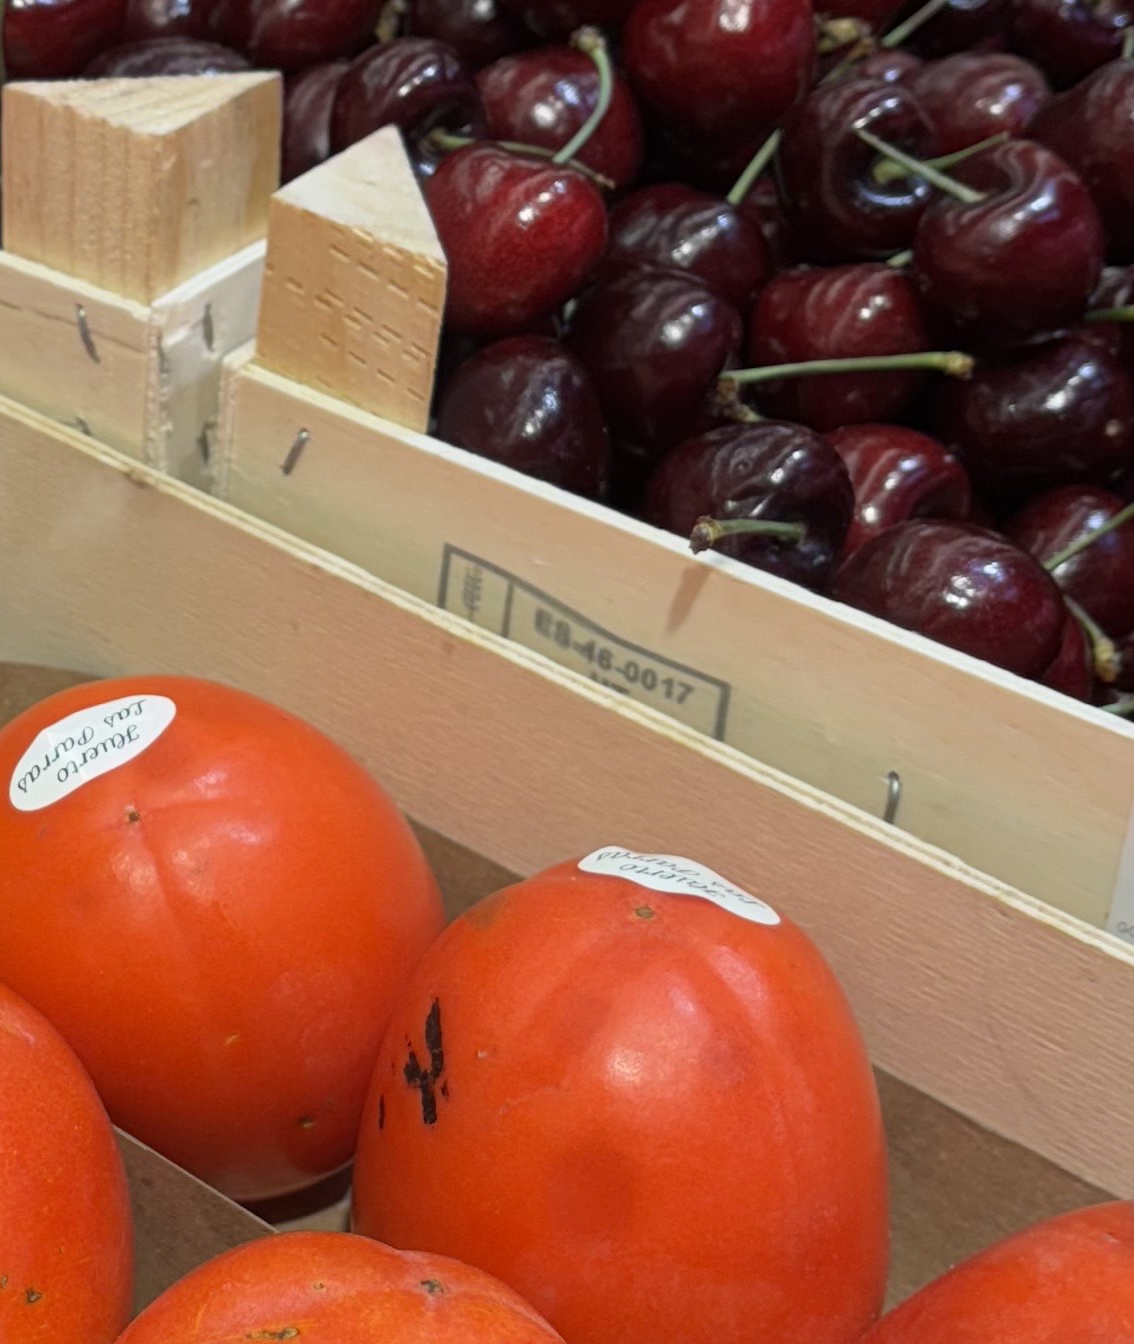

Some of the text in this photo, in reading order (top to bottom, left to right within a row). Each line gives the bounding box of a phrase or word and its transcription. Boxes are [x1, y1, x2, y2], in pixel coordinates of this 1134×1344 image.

[17, 699, 146, 793] Las Parras
[57, 724, 140, 783] Huerto
